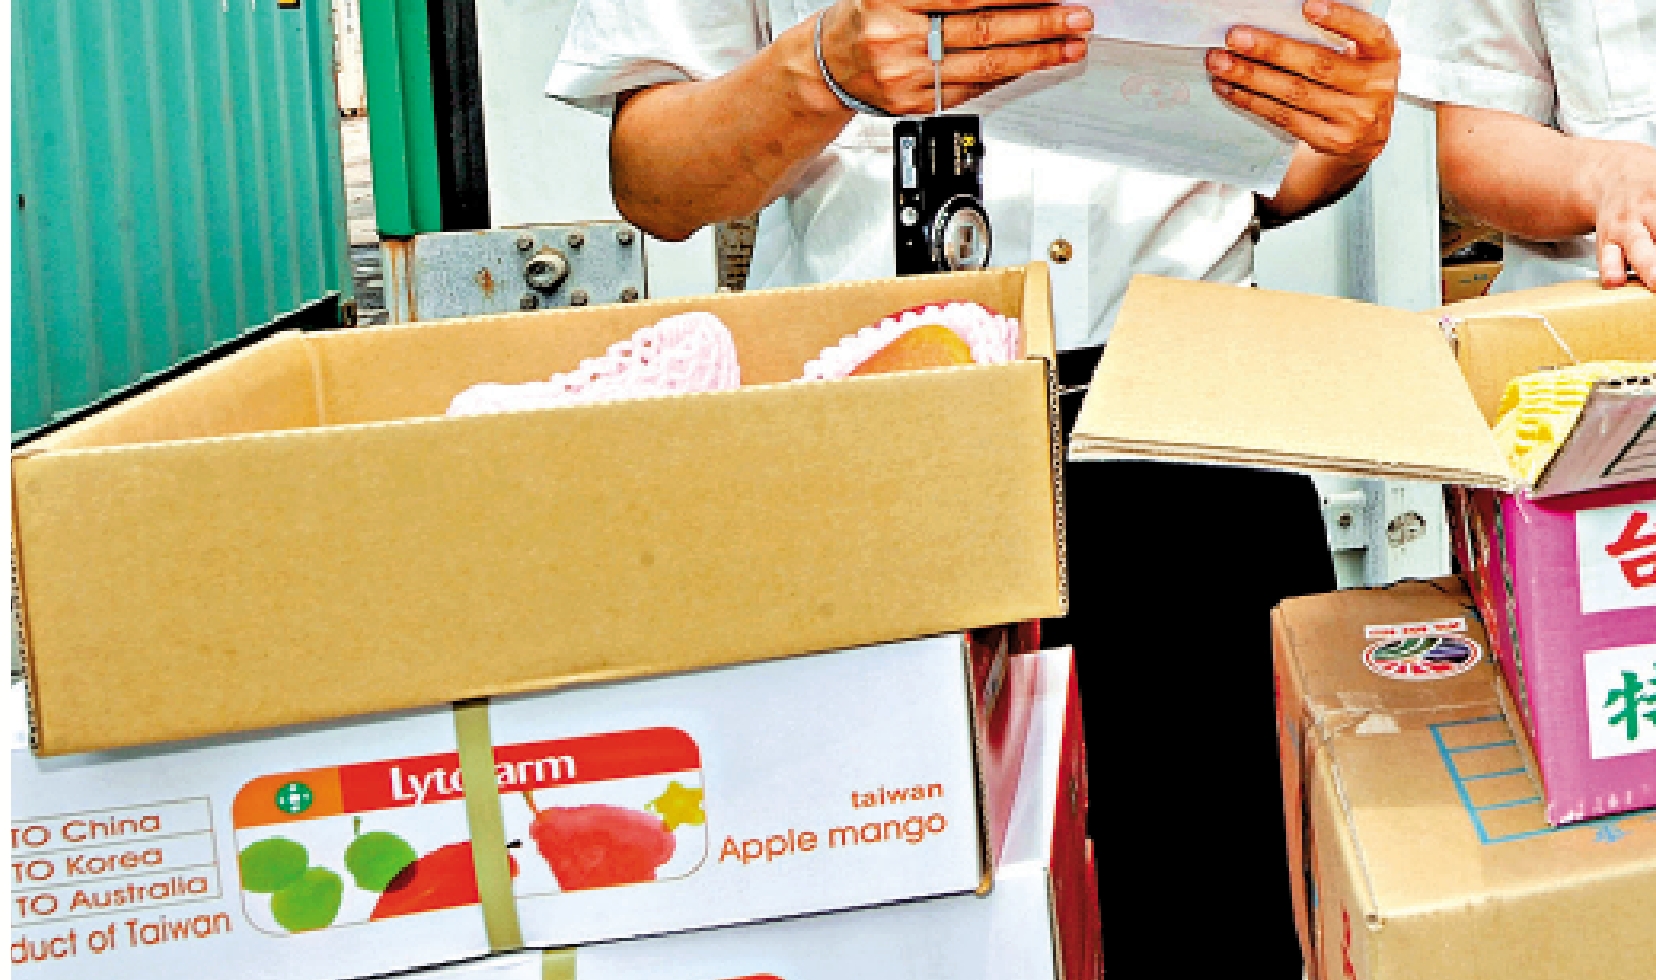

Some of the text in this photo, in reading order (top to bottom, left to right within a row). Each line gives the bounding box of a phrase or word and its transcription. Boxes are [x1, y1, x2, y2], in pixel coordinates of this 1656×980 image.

[390, 755, 578, 808] Lytarm
[850, 781, 945, 811] taiwan
[11, 815, 162, 850] TO China
[718, 811, 948, 865] Apple mango
[12, 848, 163, 883] TO Korea
[16, 875, 209, 918] TO Australia
[88, 921, 117, 955] of
[124, 912, 234, 948] Taiwan
